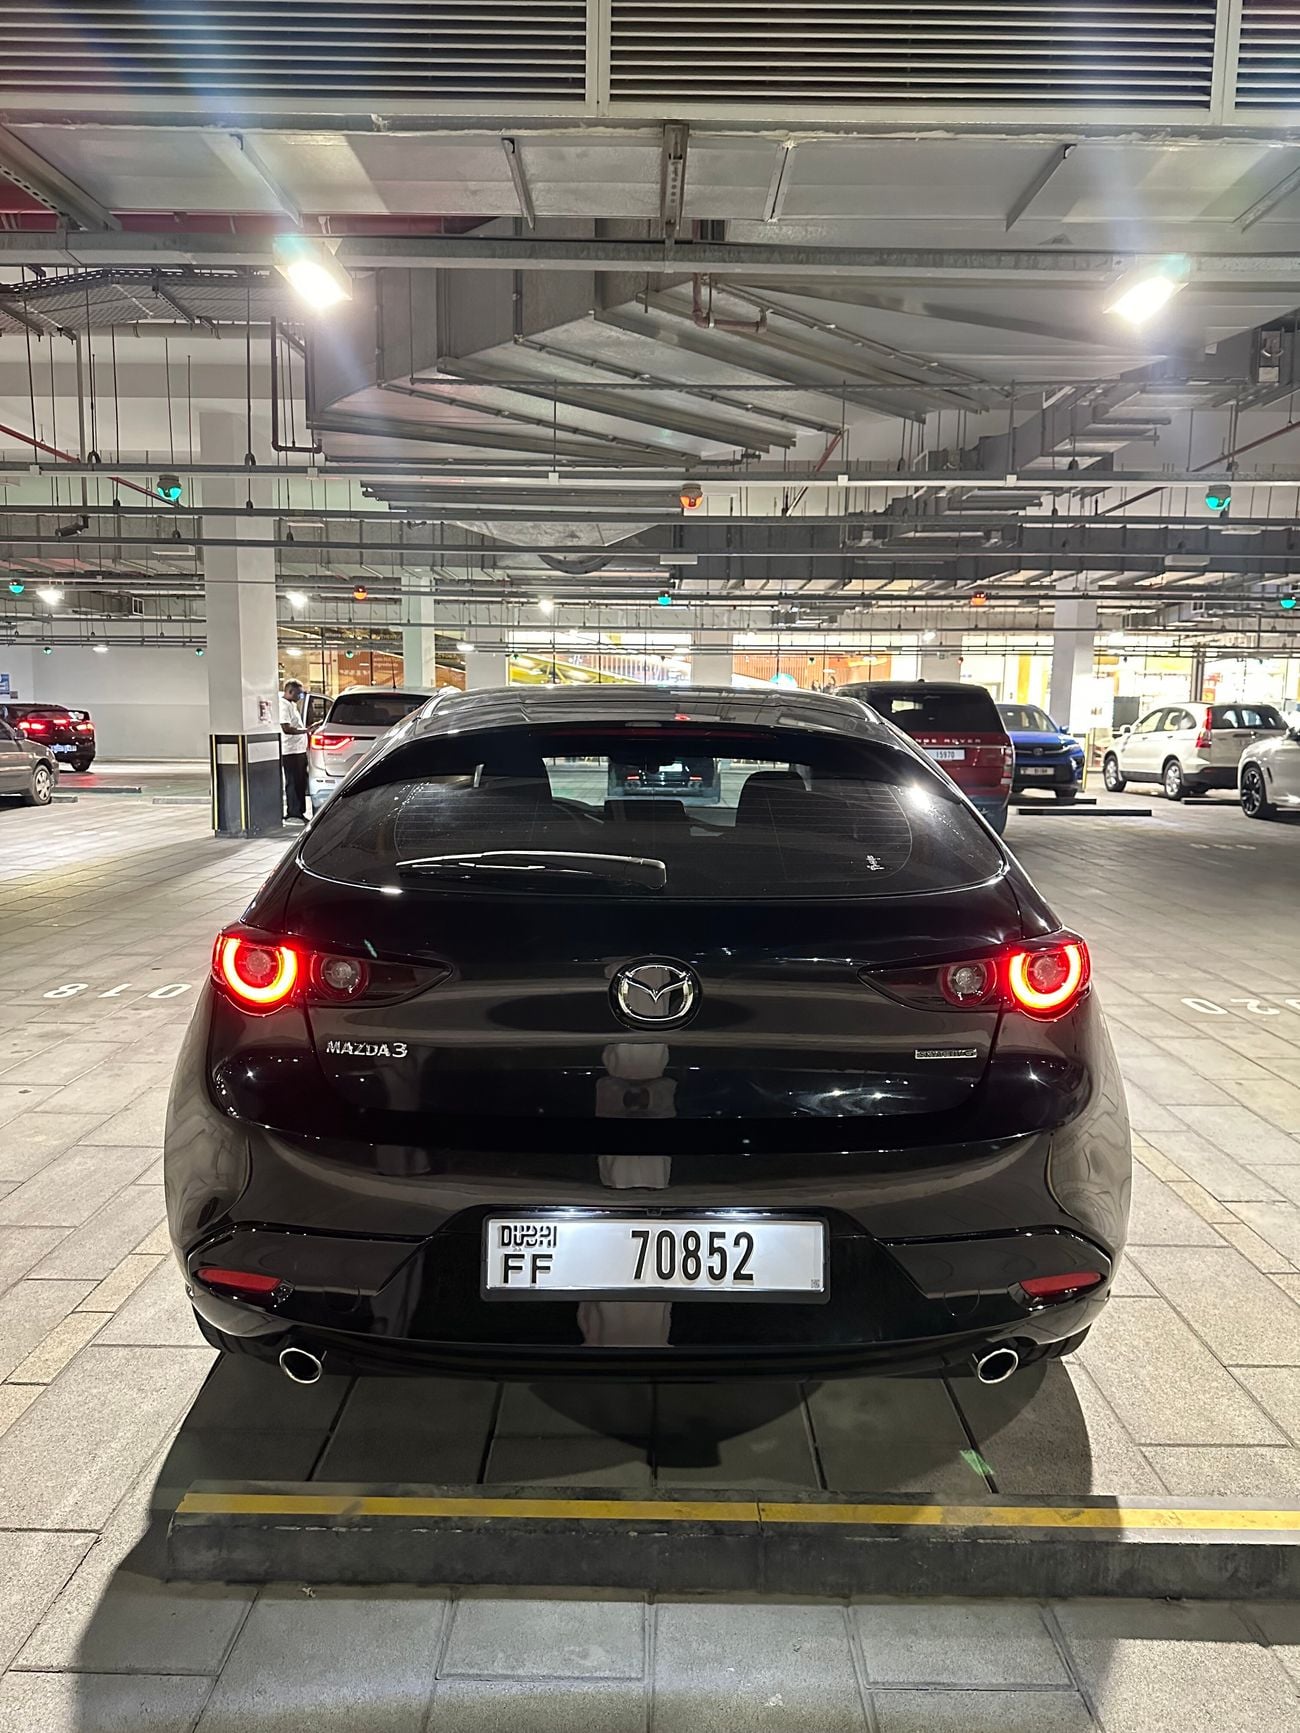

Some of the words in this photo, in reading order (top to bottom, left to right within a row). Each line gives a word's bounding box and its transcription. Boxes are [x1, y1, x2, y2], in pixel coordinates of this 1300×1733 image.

[43, 983, 193, 999] 018
[326, 1040, 408, 1058] MAZDA3
[631, 1230, 754, 1281] 70852
[503, 1254, 553, 1284] FF
